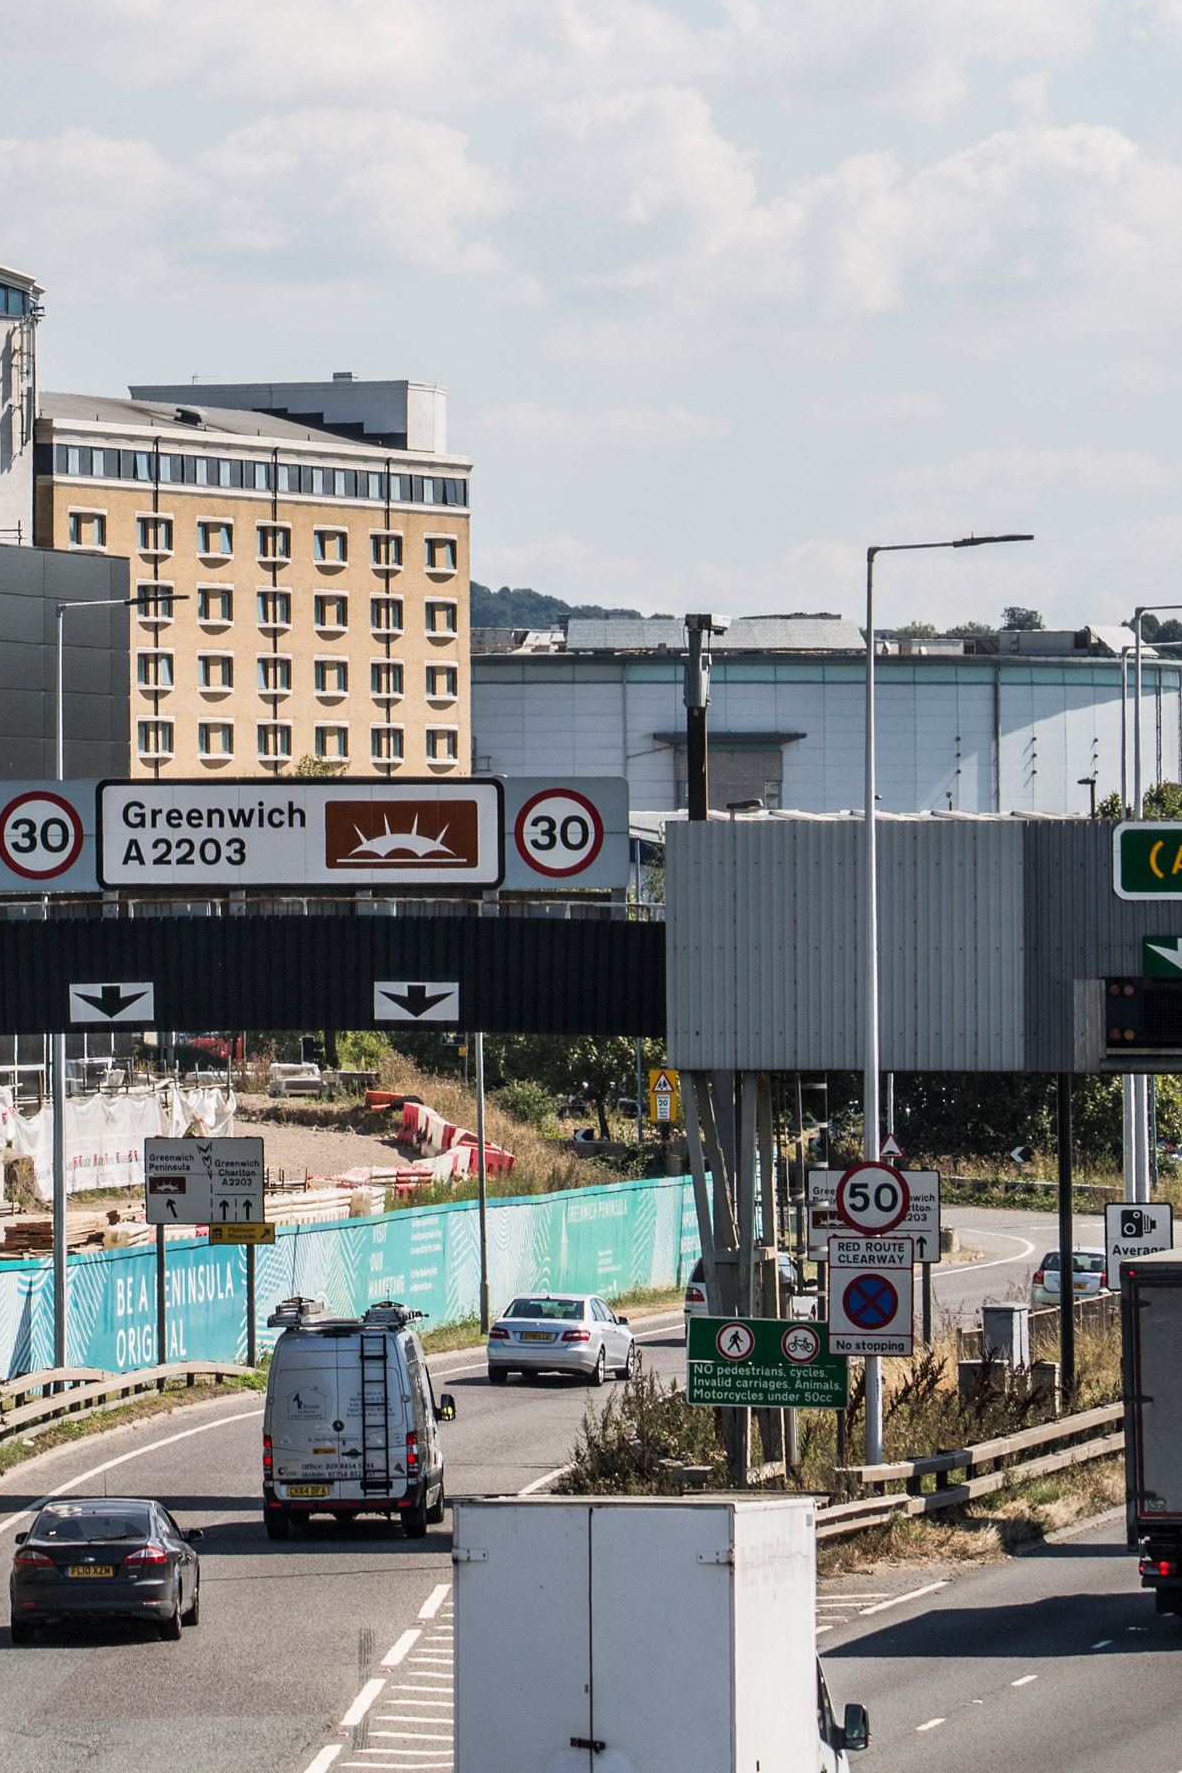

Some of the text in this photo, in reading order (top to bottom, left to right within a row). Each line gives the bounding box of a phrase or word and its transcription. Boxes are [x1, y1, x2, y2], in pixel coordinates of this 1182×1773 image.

[122, 800, 307, 828] Greenwich
[10, 817, 69, 854] 30
[530, 815, 589, 851] 30
[149, 1153, 195, 1162] Greenwich
[149, 1163, 191, 1172] Peninsula
[214, 1159, 260, 1168] Greenwich
[218, 1168, 256, 1177] Charlton
[221, 1178, 253, 1187] A2203
[848, 1182, 899, 1213] 50
[909, 1193, 935, 1202] nwich
[837, 1242, 905, 1253] RED ROUTE
[837, 1254, 905, 1264] CLEARWAY
[116, 1261, 234, 1316] BE A ENINSULA
[116, 1319, 187, 1368] ORIGIAL
[836, 1340, 905, 1352] No stopping
[693, 1364, 714, 1375] NO
[693, 1376, 732, 1387] Invalid
[693, 1388, 833, 1402] Motorcycles under 50cc
[71, 1566, 91, 1576] FL10
